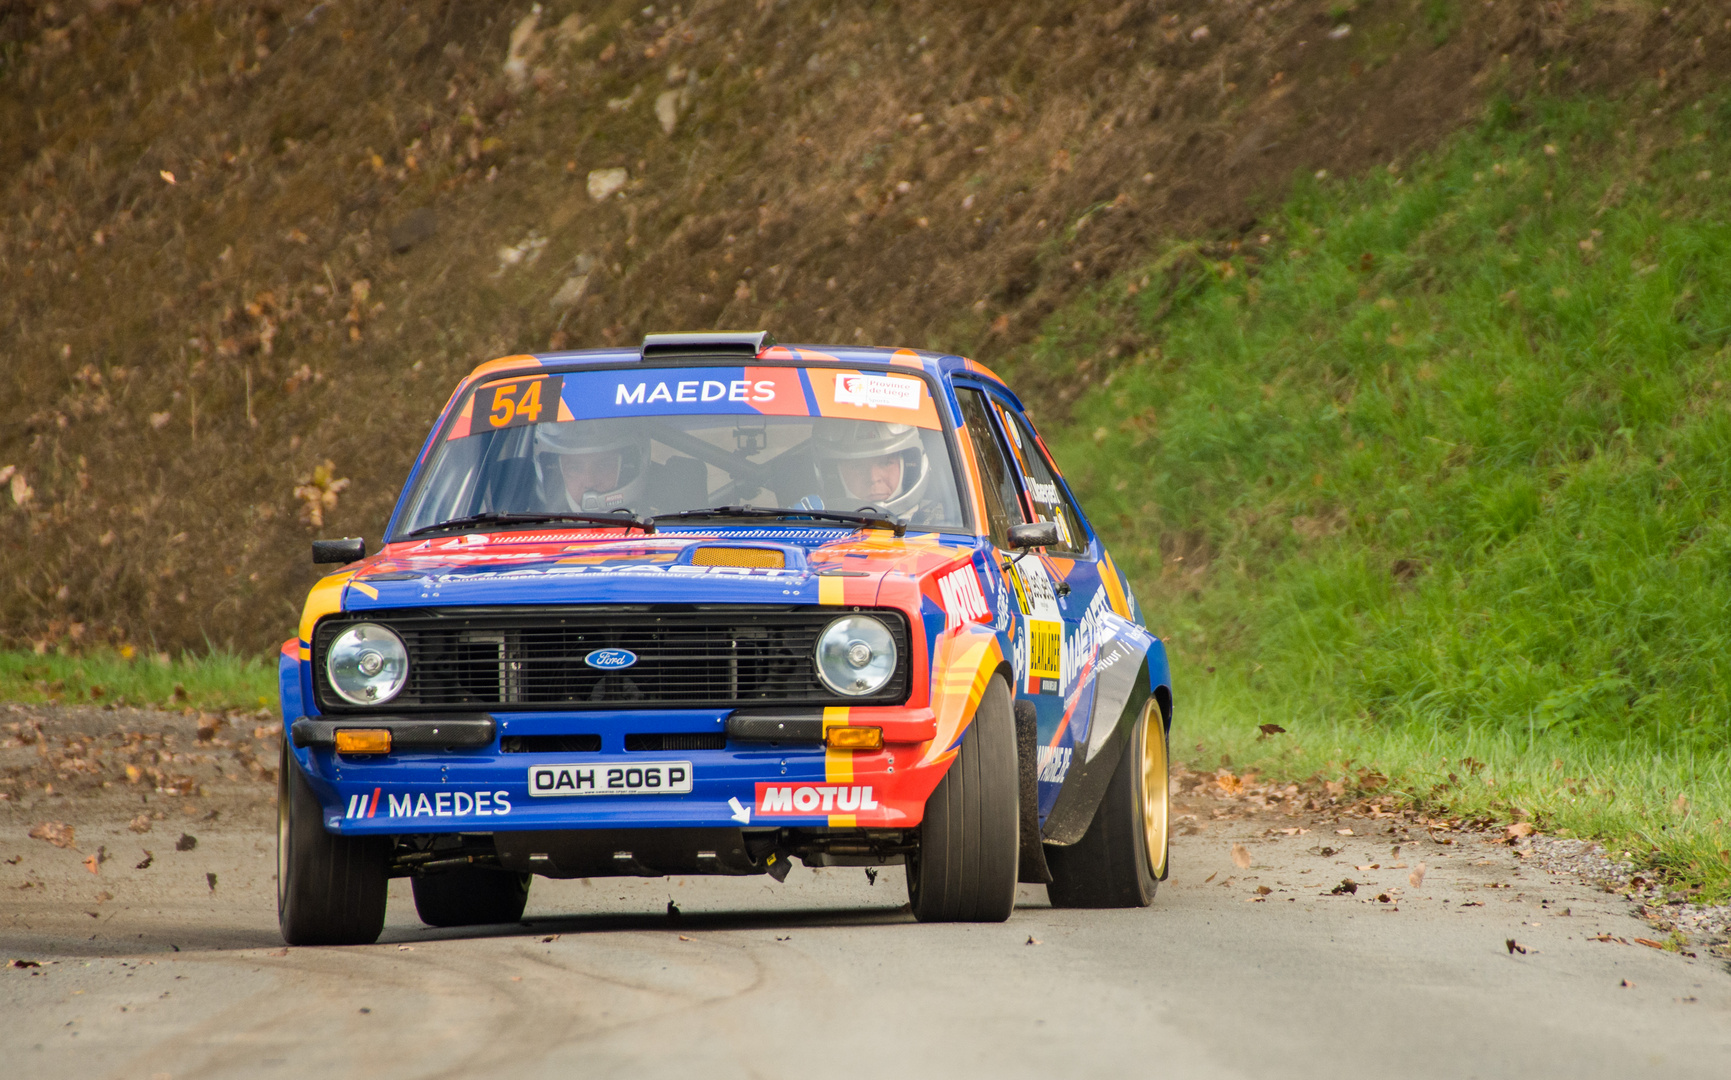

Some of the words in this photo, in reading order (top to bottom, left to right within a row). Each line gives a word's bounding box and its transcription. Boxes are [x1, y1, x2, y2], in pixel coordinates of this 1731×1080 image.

[614, 380, 776, 405] MAEDES
[869, 380, 911, 390] Province
[488, 380, 543, 428] 54
[564, 571, 631, 579] Container
[715, 573, 785, 583] Recyclage
[937, 563, 989, 630] MOTUL
[596, 651, 626, 665] Ford
[535, 769, 596, 791] OAH
[607, 767, 662, 789] 206
[668, 767, 686, 788] P
[388, 790, 512, 818] MAEDES
[761, 786, 879, 812] MOTUL
